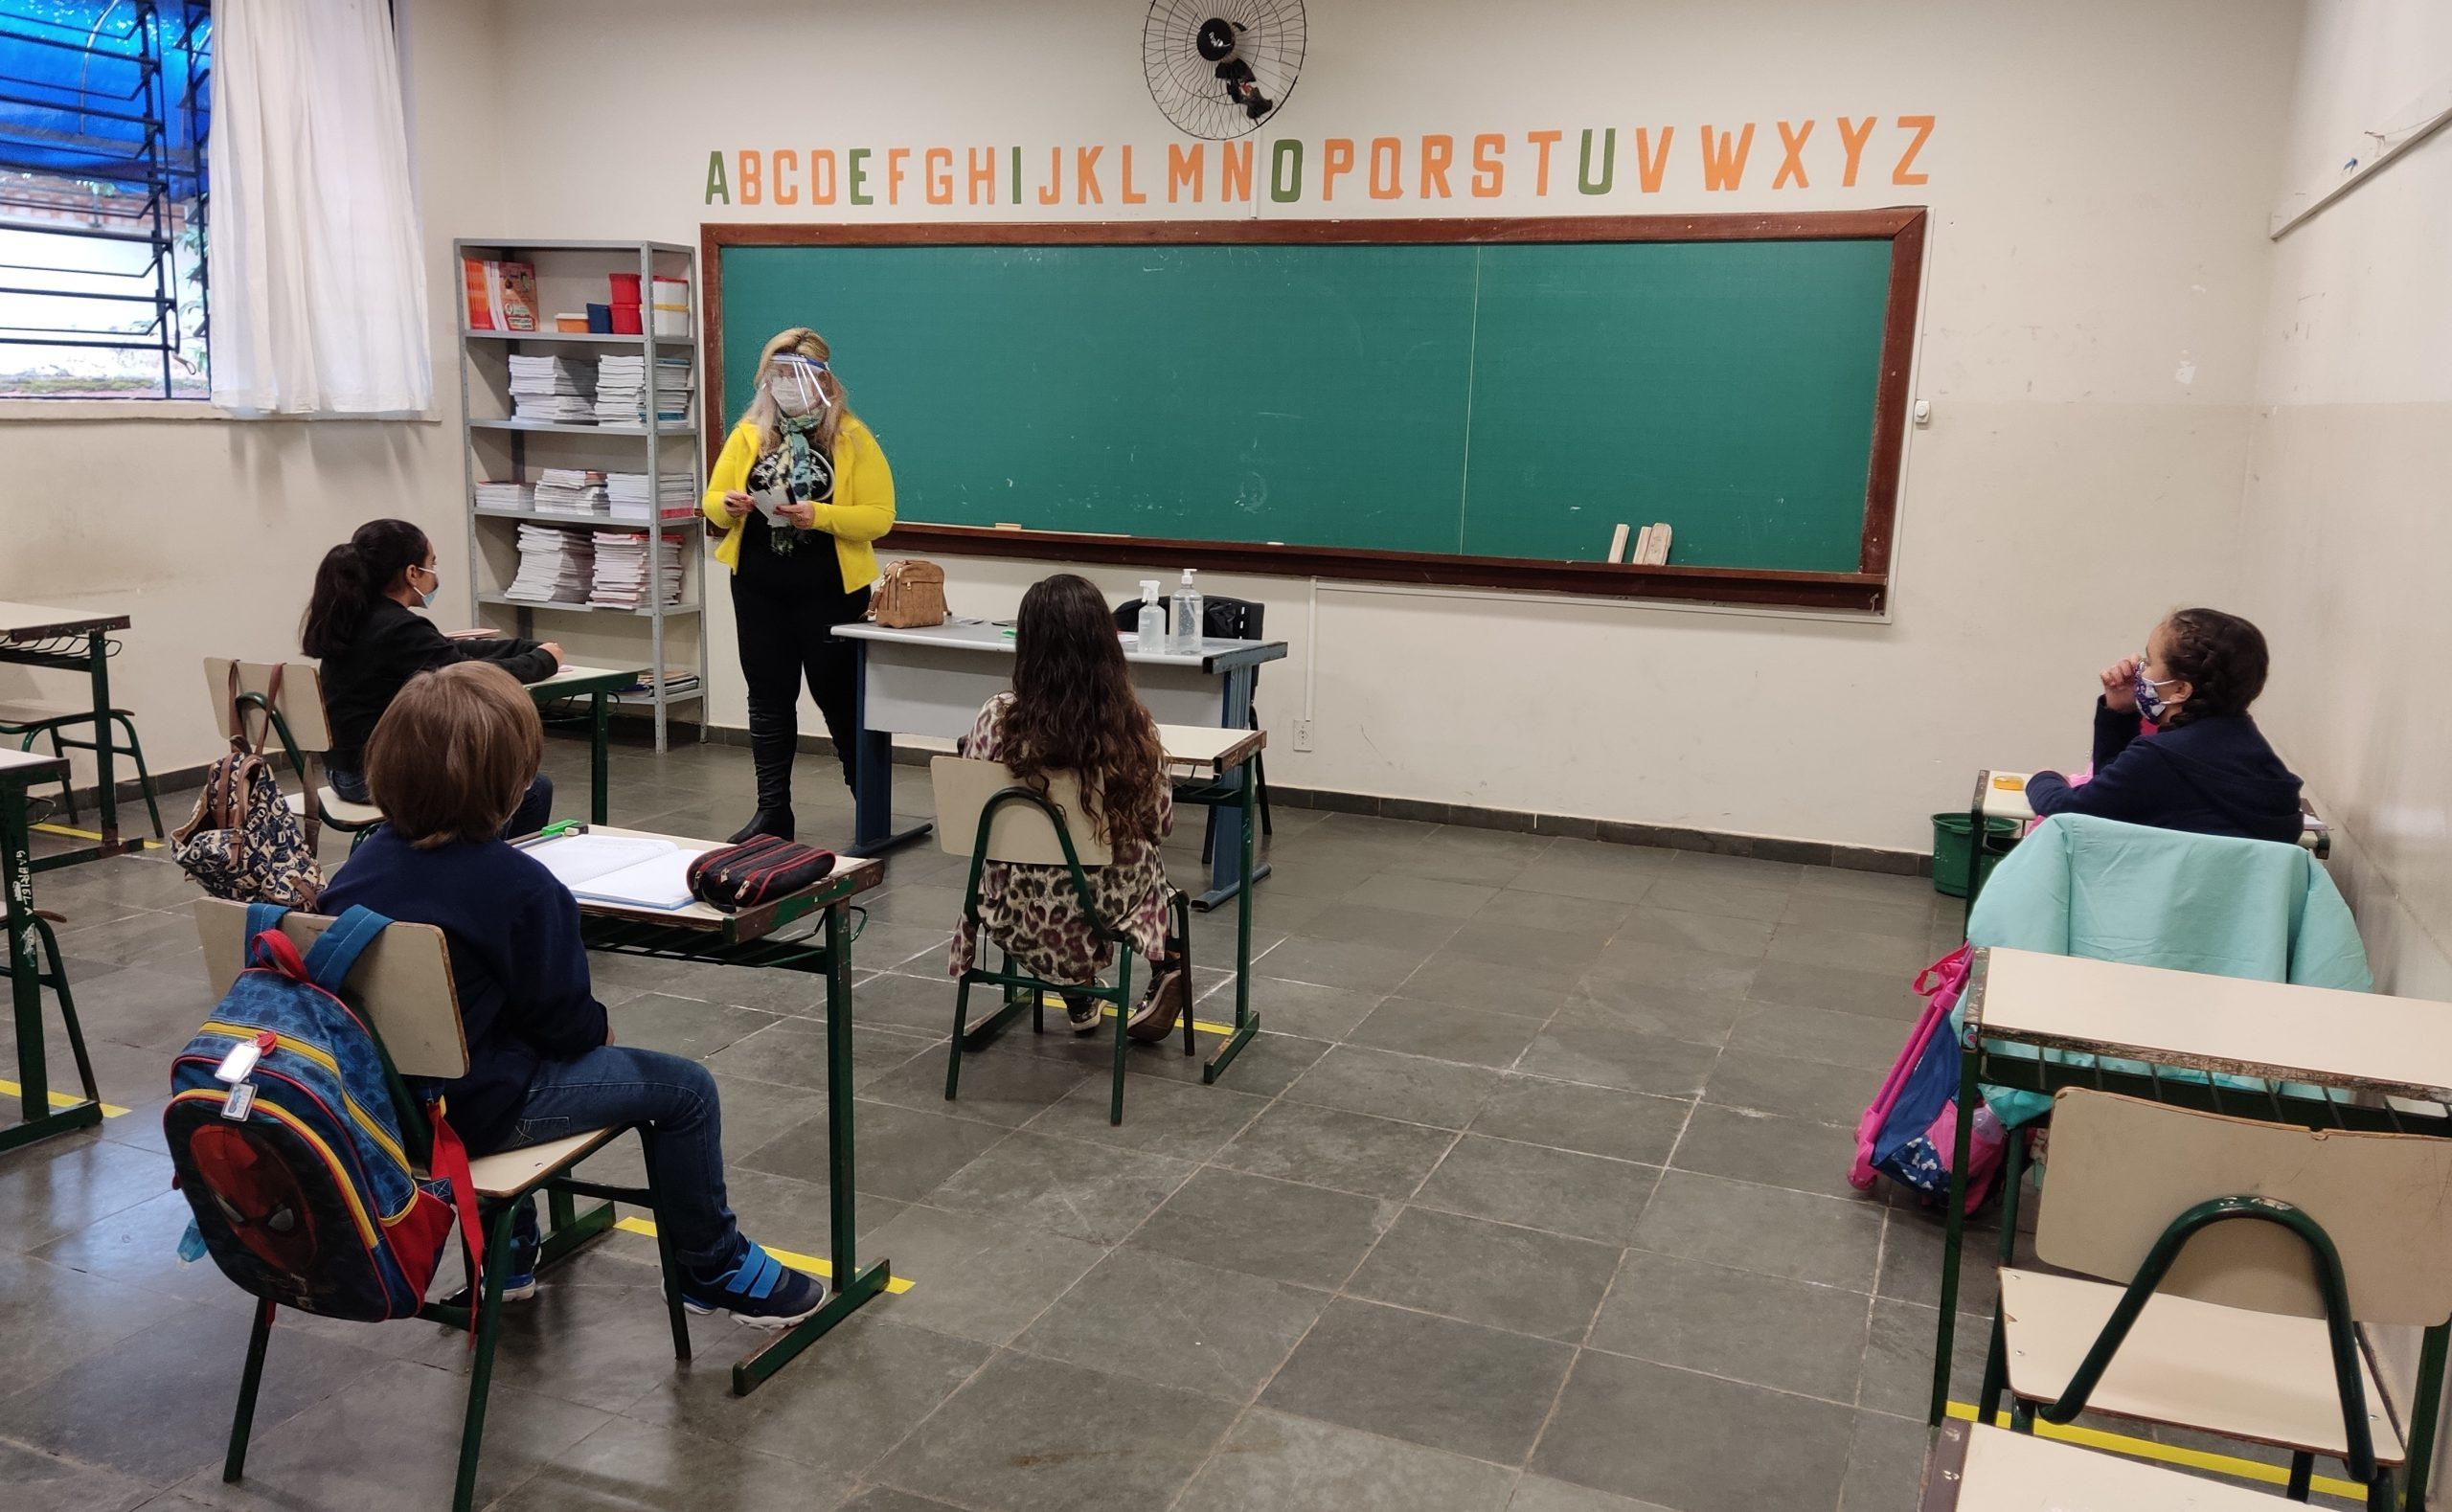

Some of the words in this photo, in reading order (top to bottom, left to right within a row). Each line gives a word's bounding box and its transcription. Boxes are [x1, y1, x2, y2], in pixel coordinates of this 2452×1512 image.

[705, 150, 731, 205] A
[738, 149, 761, 205] B
[772, 149, 799, 206] C
[810, 148, 836, 206] D
[849, 148, 874, 205] E
[888, 147, 910, 206] F
[925, 147, 953, 205] G
[967, 146, 995, 205] H
[1011, 147, 1021, 204] I
[1038, 147, 1061, 206] J
[1077, 145, 1104, 205] K
[1122, 145, 1147, 204] L
[1168, 142, 1204, 203] M
[1221, 140, 1254, 203] N
[1271, 139, 1304, 203] O
[1322, 137, 1354, 201] P
[1369, 136, 1404, 200] Q
[1419, 133, 1454, 199] R
[1471, 133, 1506, 198] S
[1527, 129, 1562, 196] T
[1578, 127, 1616, 195] U
[1635, 125, 1674, 193] V
[1700, 123, 1756, 192] W
[1772, 120, 1814, 190] X
[1837, 116, 1877, 188] Y
[1892, 115, 1936, 186] Z
